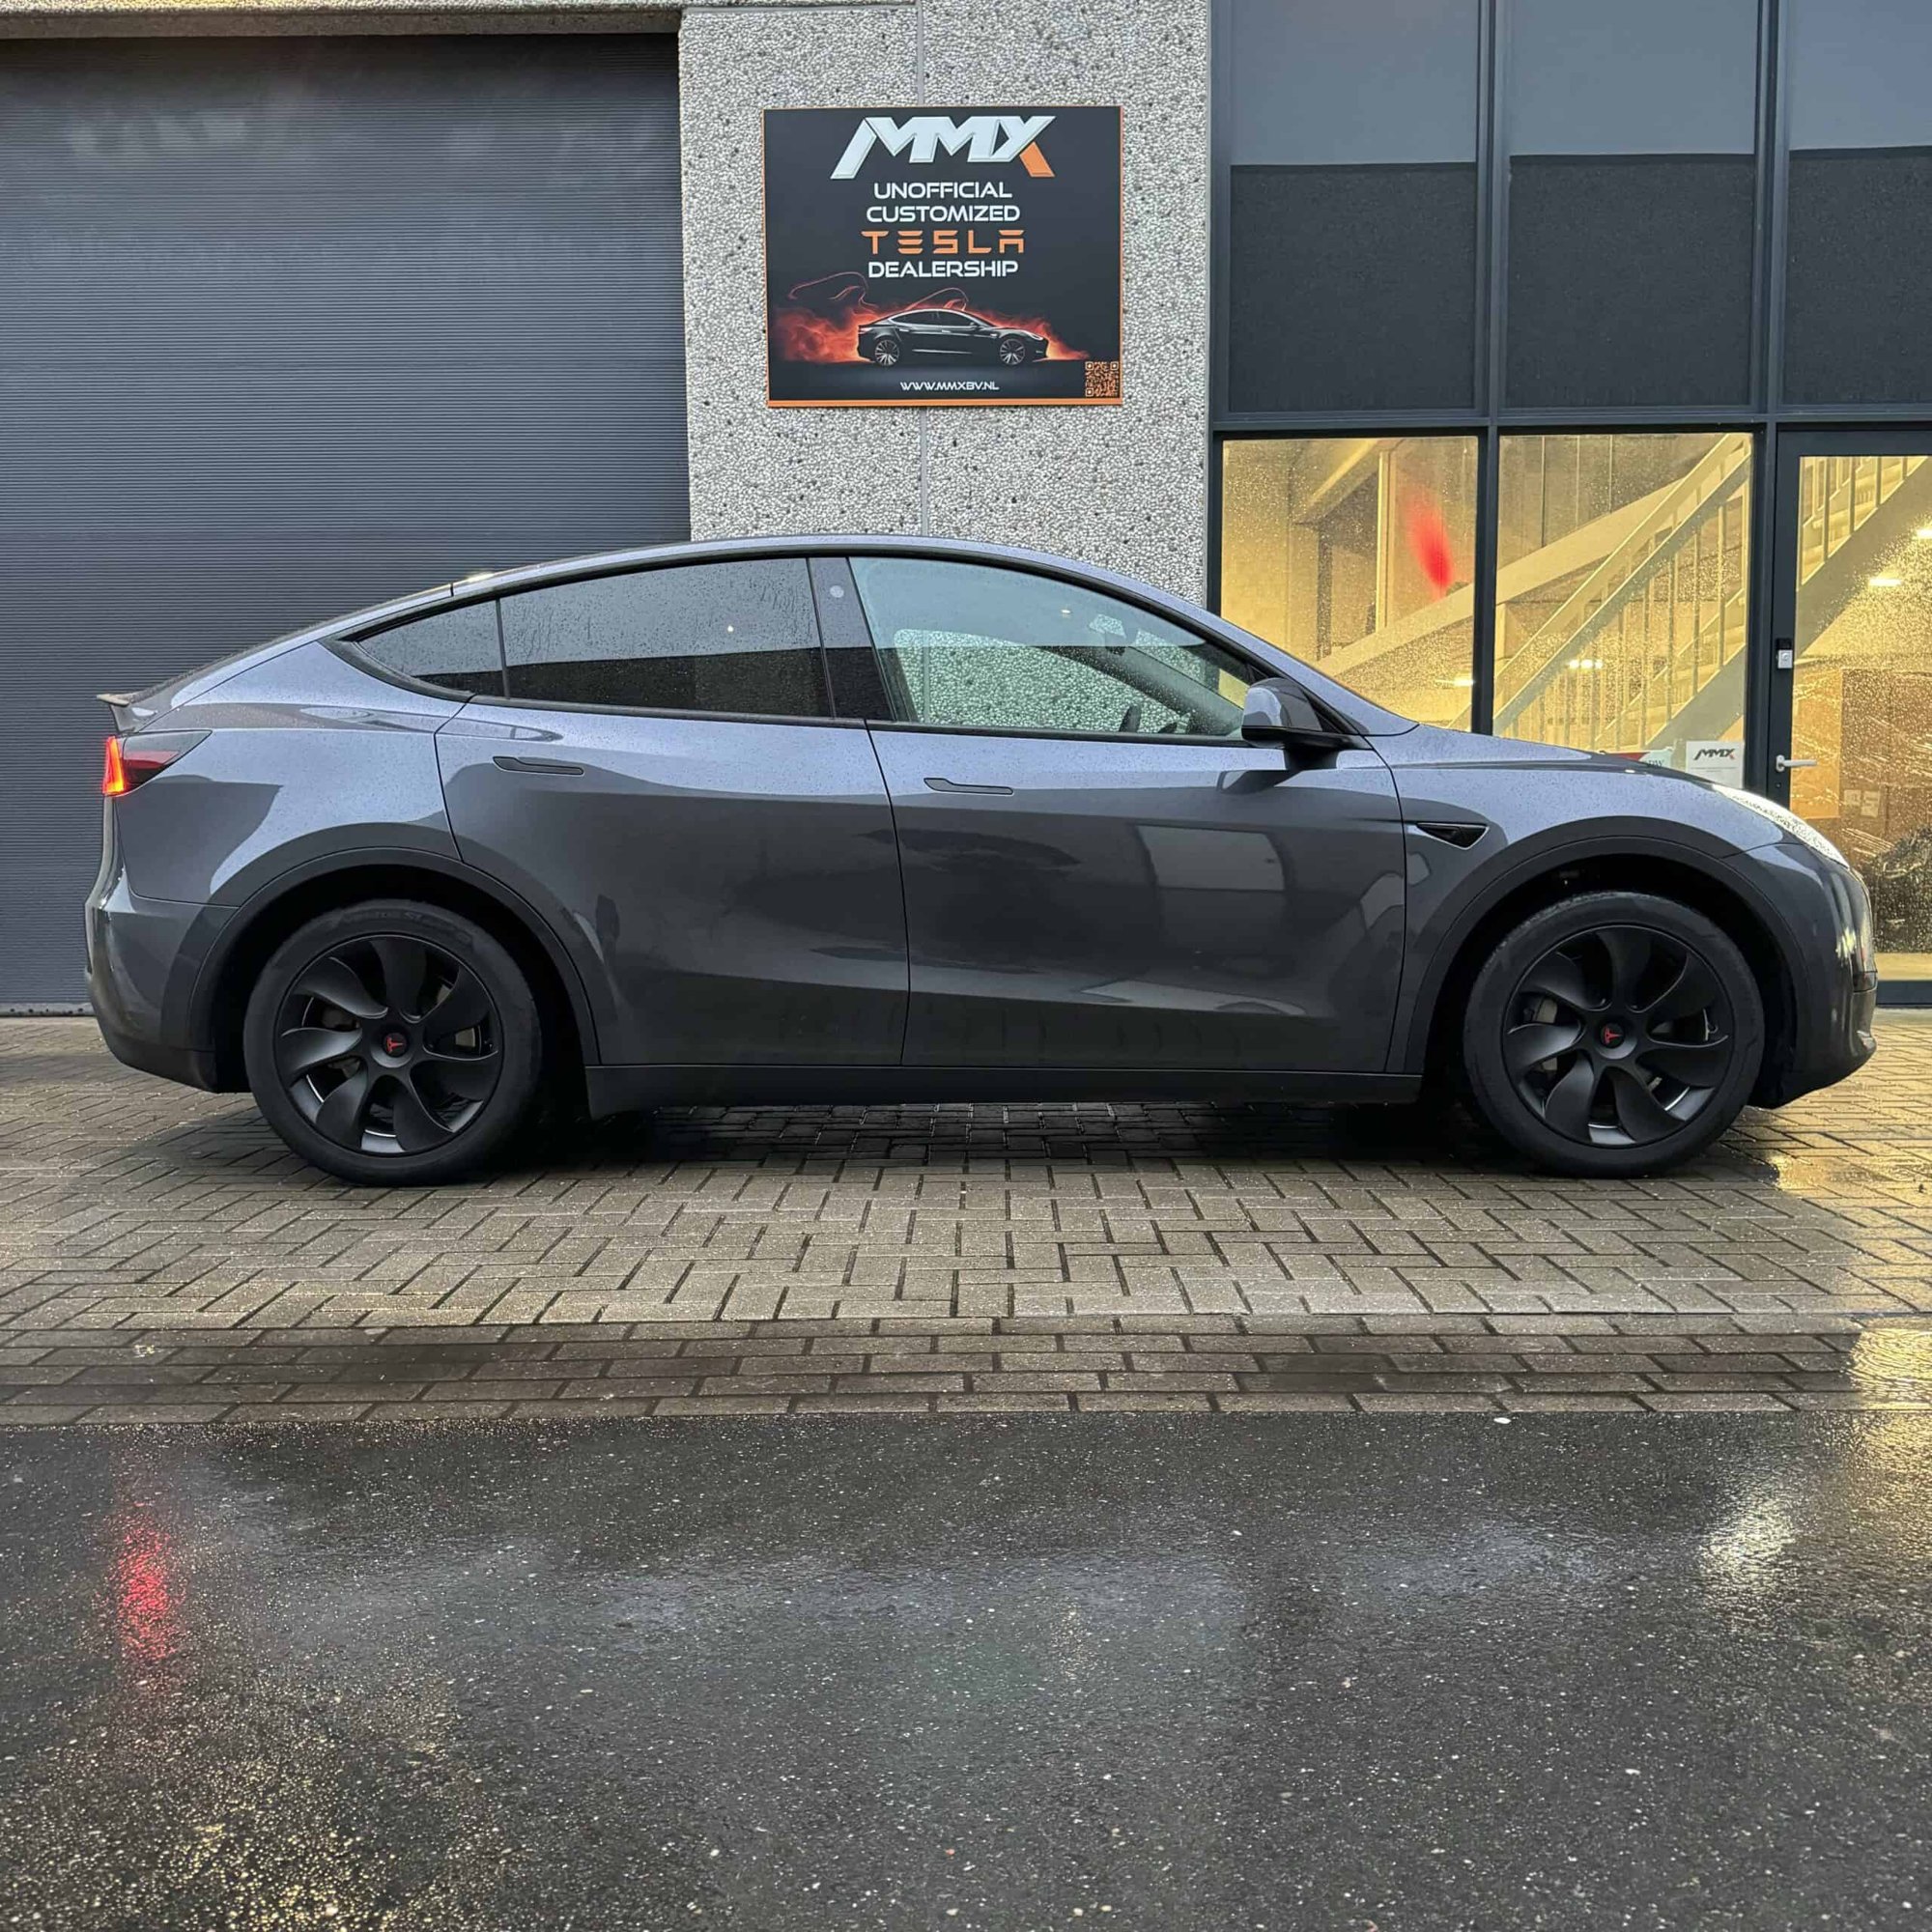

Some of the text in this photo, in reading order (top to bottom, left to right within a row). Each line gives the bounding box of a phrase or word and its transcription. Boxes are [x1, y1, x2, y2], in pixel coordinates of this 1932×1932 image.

[830, 115, 1056, 180] MMX
[873, 181, 1013, 200] UNOFFICIAL
[866, 205, 1021, 223] CUSTOMIZED
[861, 230, 1025, 255] TESLA
[867, 260, 1019, 278] DEALERSHIP
[899, 381, 1000, 391] WWW.MMXBV.NL
[1692, 748, 1736, 761] MMX
